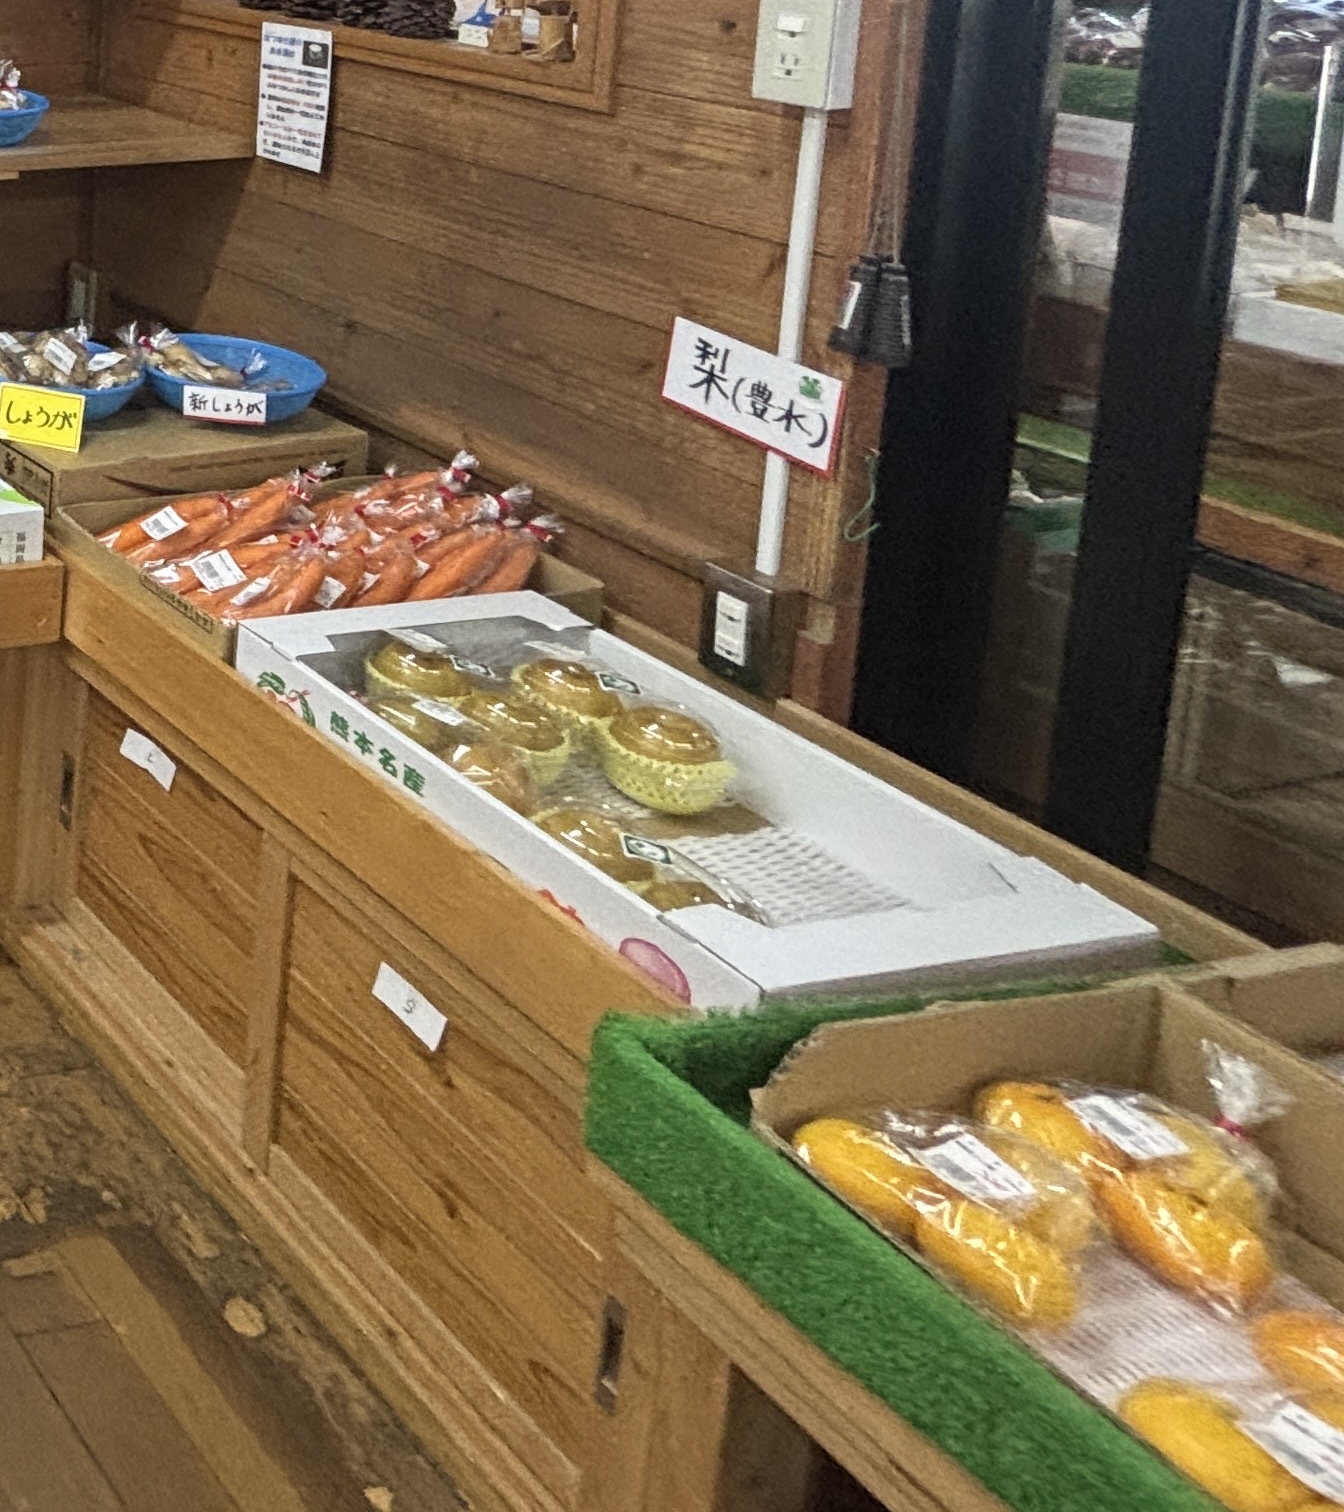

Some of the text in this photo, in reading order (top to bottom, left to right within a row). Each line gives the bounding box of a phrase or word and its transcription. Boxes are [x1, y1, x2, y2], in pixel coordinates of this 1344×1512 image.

[6, 400, 77, 430] しょうが
[187, 391, 266, 418] 新しょうが
[688, 336, 828, 449] 梨(豊水)
[330, 711, 425, 798] 熊本名産
